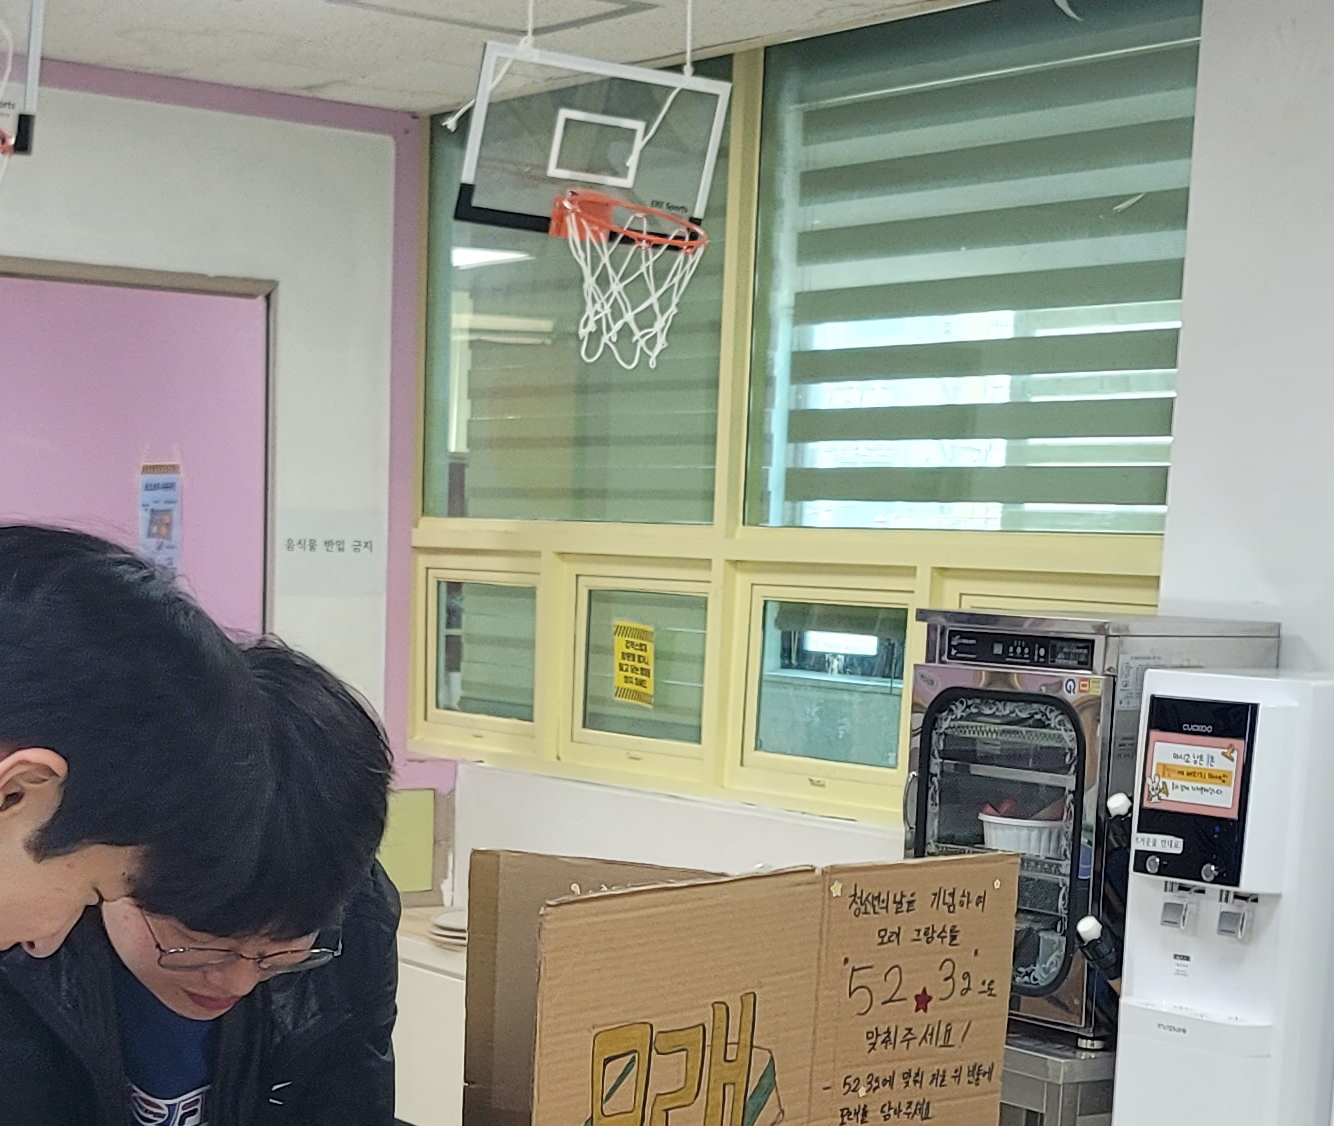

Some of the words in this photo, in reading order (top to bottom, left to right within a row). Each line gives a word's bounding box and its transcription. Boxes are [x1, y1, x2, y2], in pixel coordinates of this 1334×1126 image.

[285, 538, 317, 552] 음식물
[323, 539, 345, 553] 반입
[351, 540, 373, 553] 금지
[1182, 723, 1213, 733] CUCKOO
[930, 886, 987, 914] 기념하여
[877, 926, 901, 946] 모래
